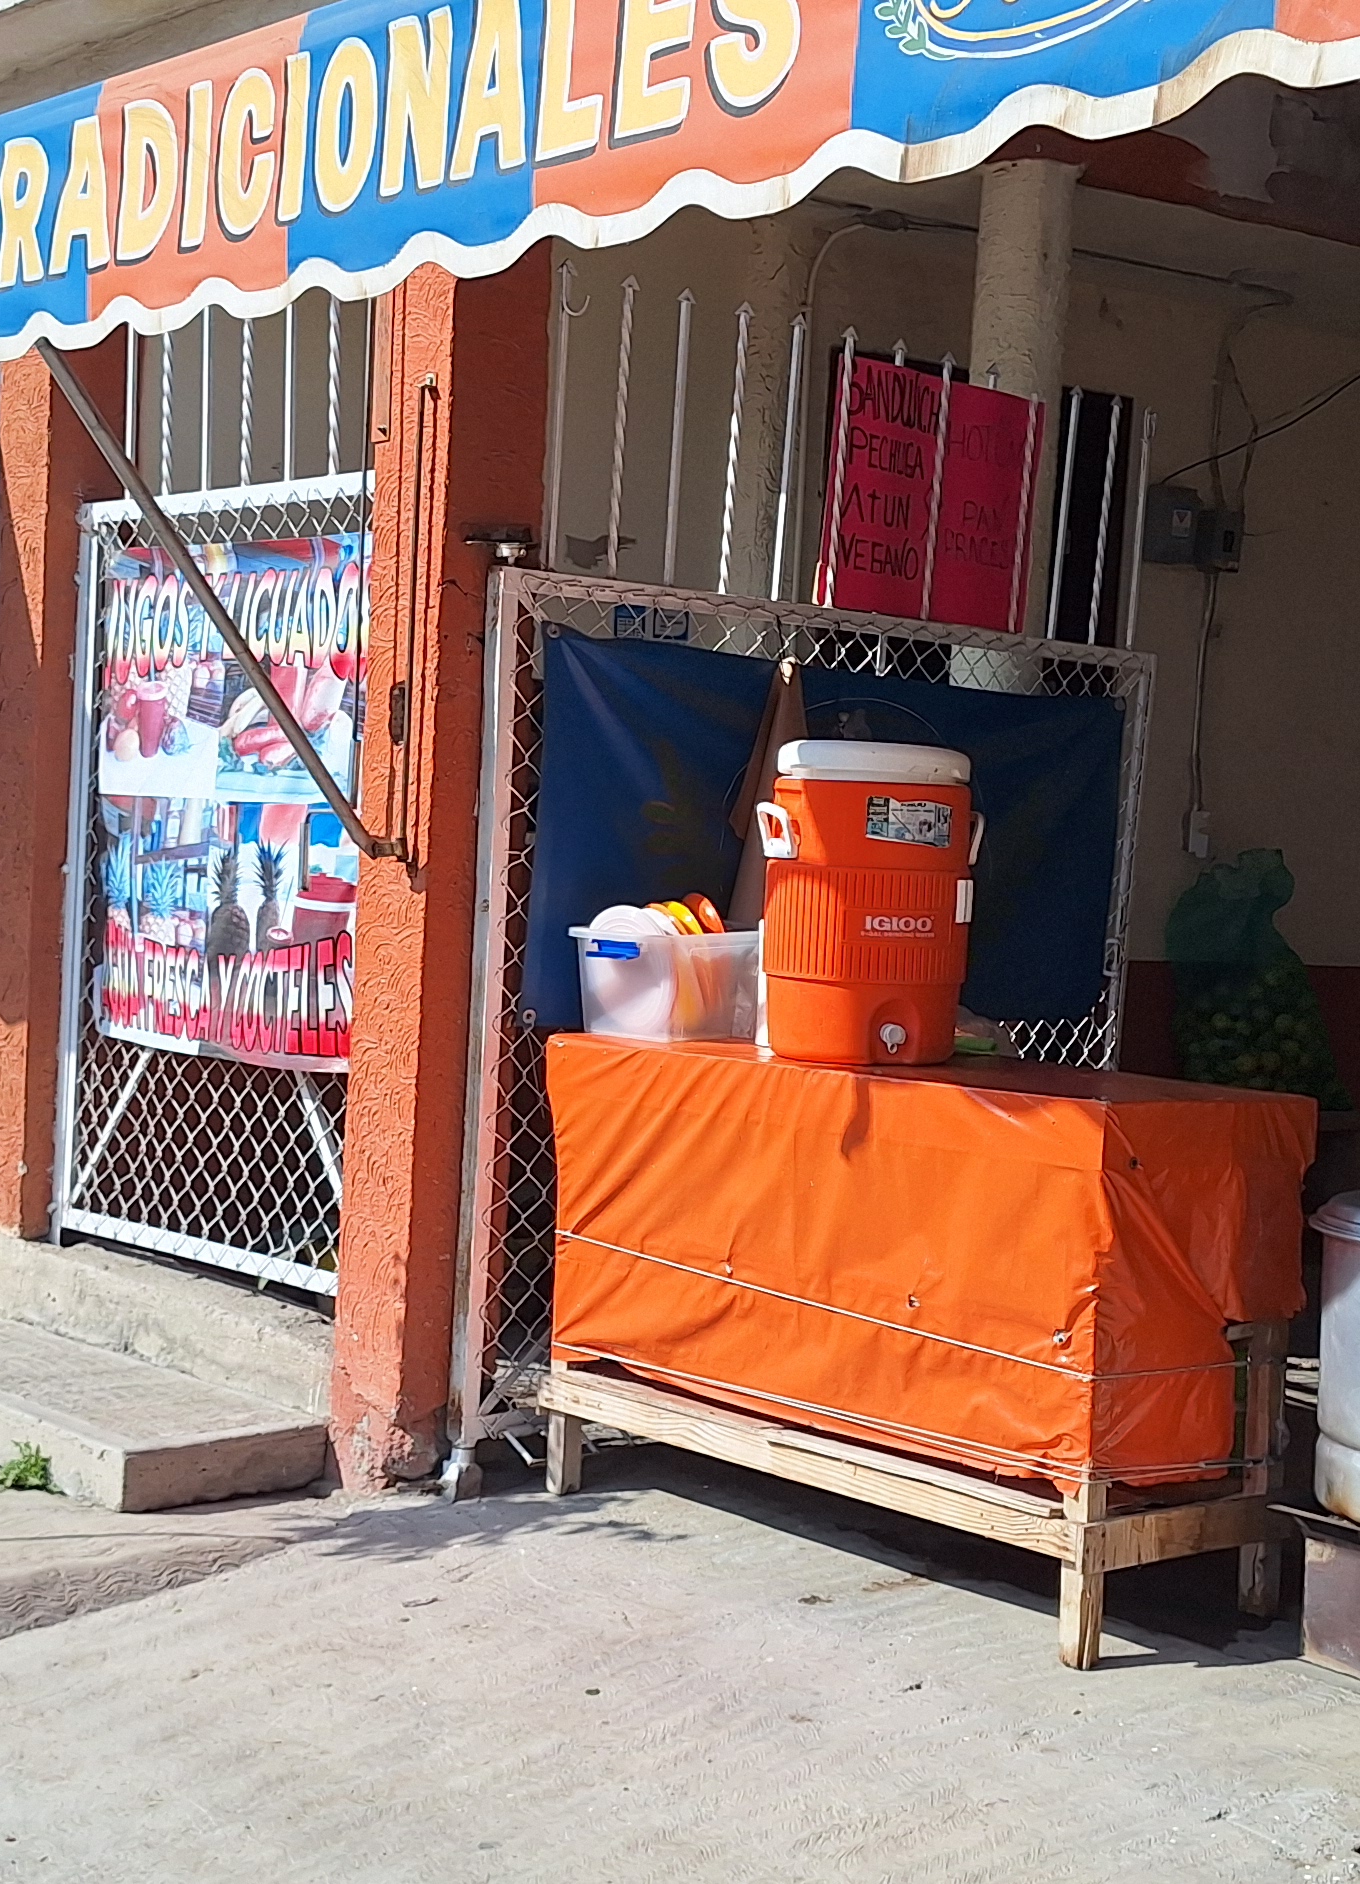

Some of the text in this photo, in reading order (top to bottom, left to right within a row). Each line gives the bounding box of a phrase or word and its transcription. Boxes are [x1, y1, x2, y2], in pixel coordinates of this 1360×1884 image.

[848, 426, 925, 480] PECHUGA
[840, 532, 919, 581] VEGANO
[864, 914, 935, 932] IGLOO
[142, 937, 210, 1042] FRESCA
[215, 953, 237, 1043] Y
[229, 929, 355, 1059] COCTELES
